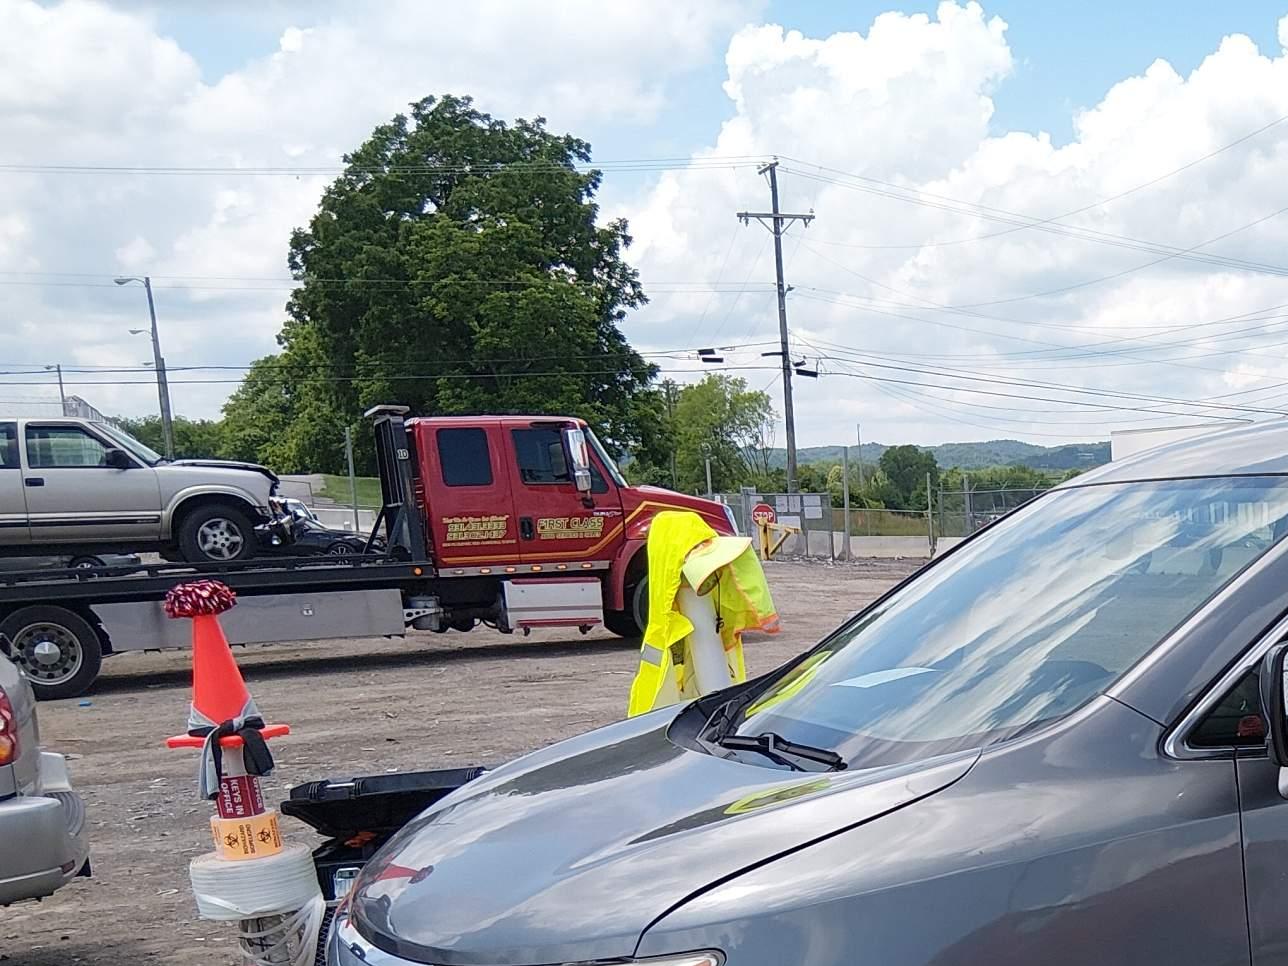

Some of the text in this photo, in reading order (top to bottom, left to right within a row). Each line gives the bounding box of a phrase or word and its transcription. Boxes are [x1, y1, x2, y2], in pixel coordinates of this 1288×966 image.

[537, 517, 604, 530] FIRST CLASS
[754, 512, 773, 521] STOP
[221, 783, 234, 814] OFFICE
[230, 780, 245, 815] KEYS IN
[252, 777, 262, 808] OFFICE
